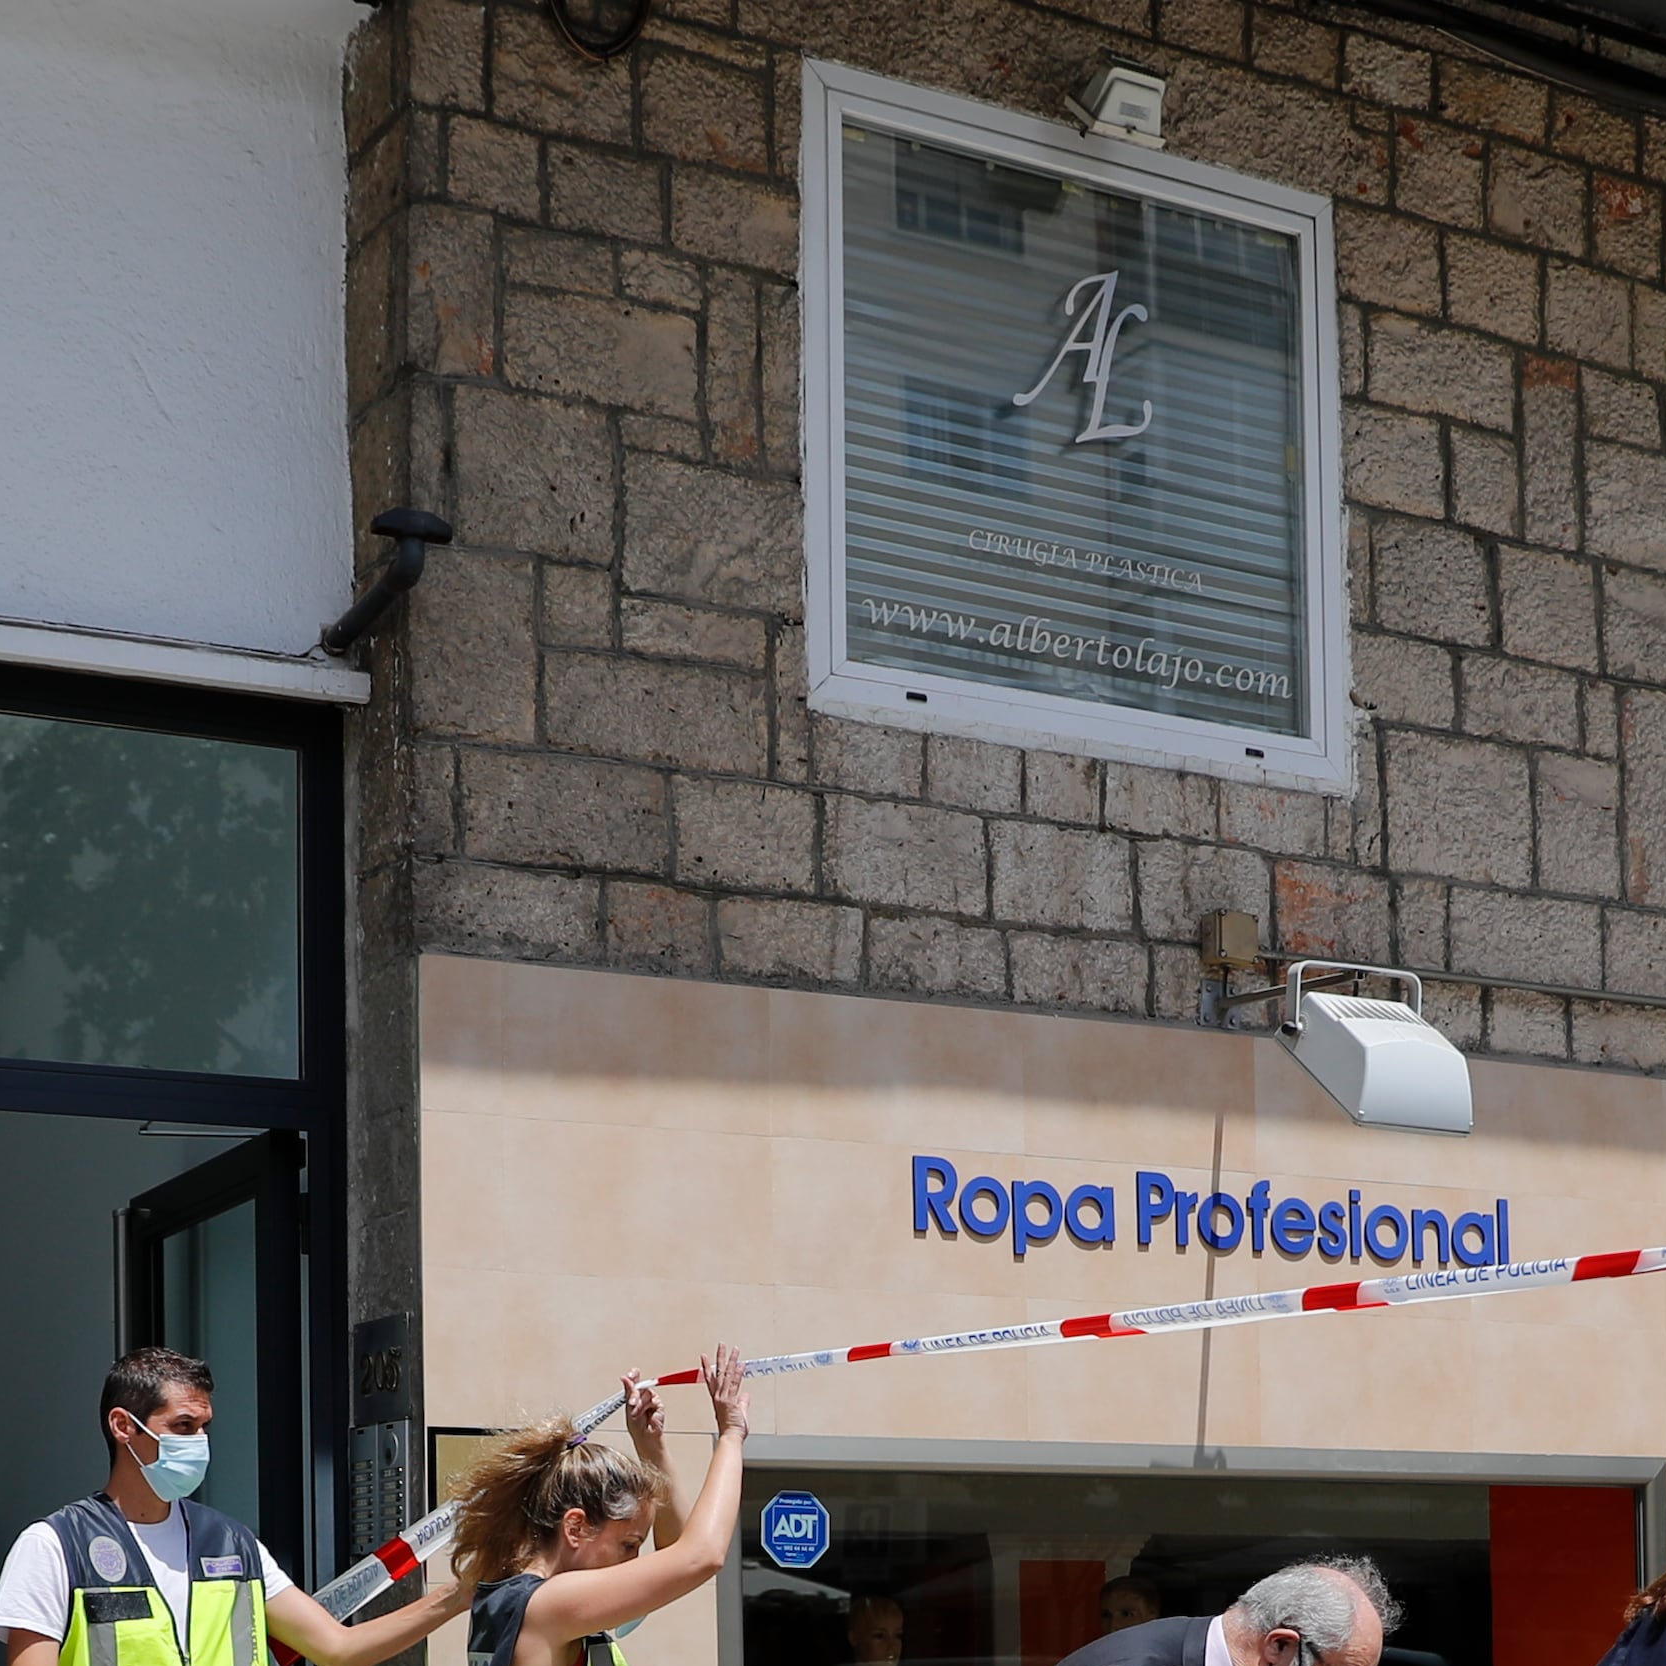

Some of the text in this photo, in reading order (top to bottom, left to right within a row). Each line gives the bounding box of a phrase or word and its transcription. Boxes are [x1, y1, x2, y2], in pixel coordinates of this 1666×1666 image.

[862, 597, 1293, 700] www.albertolajo.com
[911, 1155, 1510, 1267] Ropa Profesional
[360, 1345, 402, 1398] 205
[773, 1513, 818, 1540] ADT
